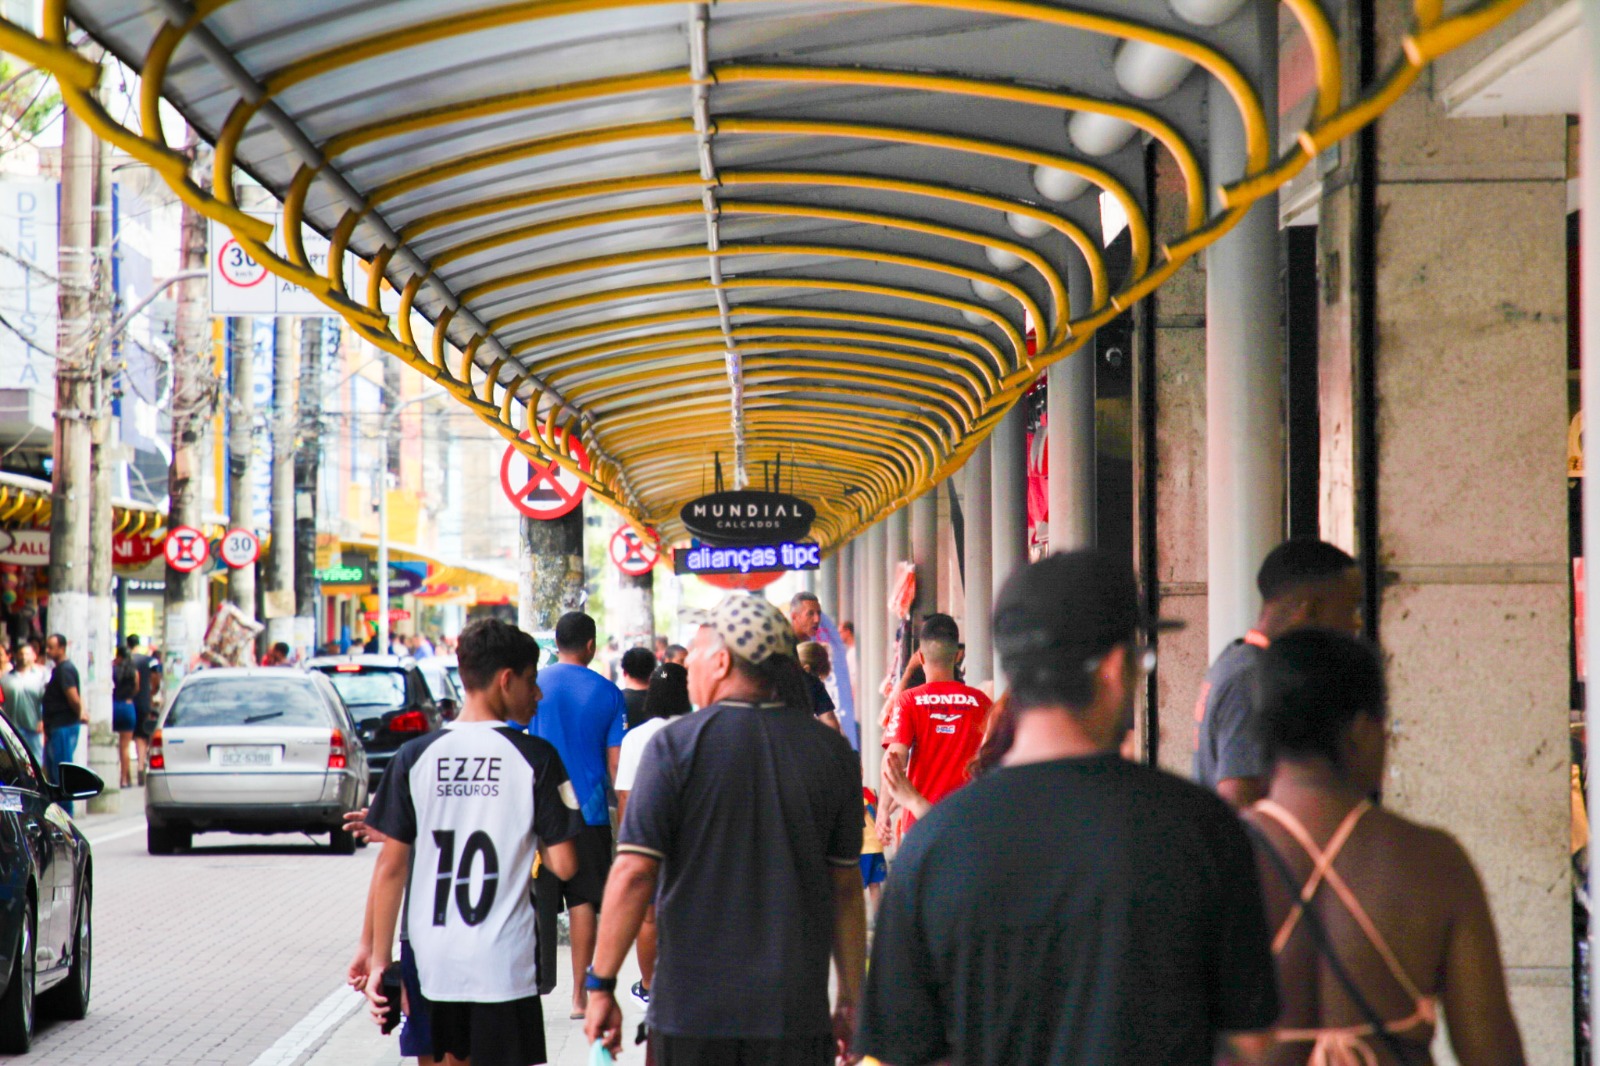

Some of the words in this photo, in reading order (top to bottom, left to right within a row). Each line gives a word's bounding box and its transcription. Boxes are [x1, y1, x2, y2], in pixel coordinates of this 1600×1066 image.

[17, 191, 40, 384] DENTISTA
[693, 504, 802, 517] MUNDIAL
[230, 537, 252, 552] 30
[687, 547, 777, 573] alianças
[914, 694, 979, 707] HONDA
[437, 757, 502, 782] EZZE
[436, 784, 500, 797] SEGUROS
[431, 829, 500, 927] 10
